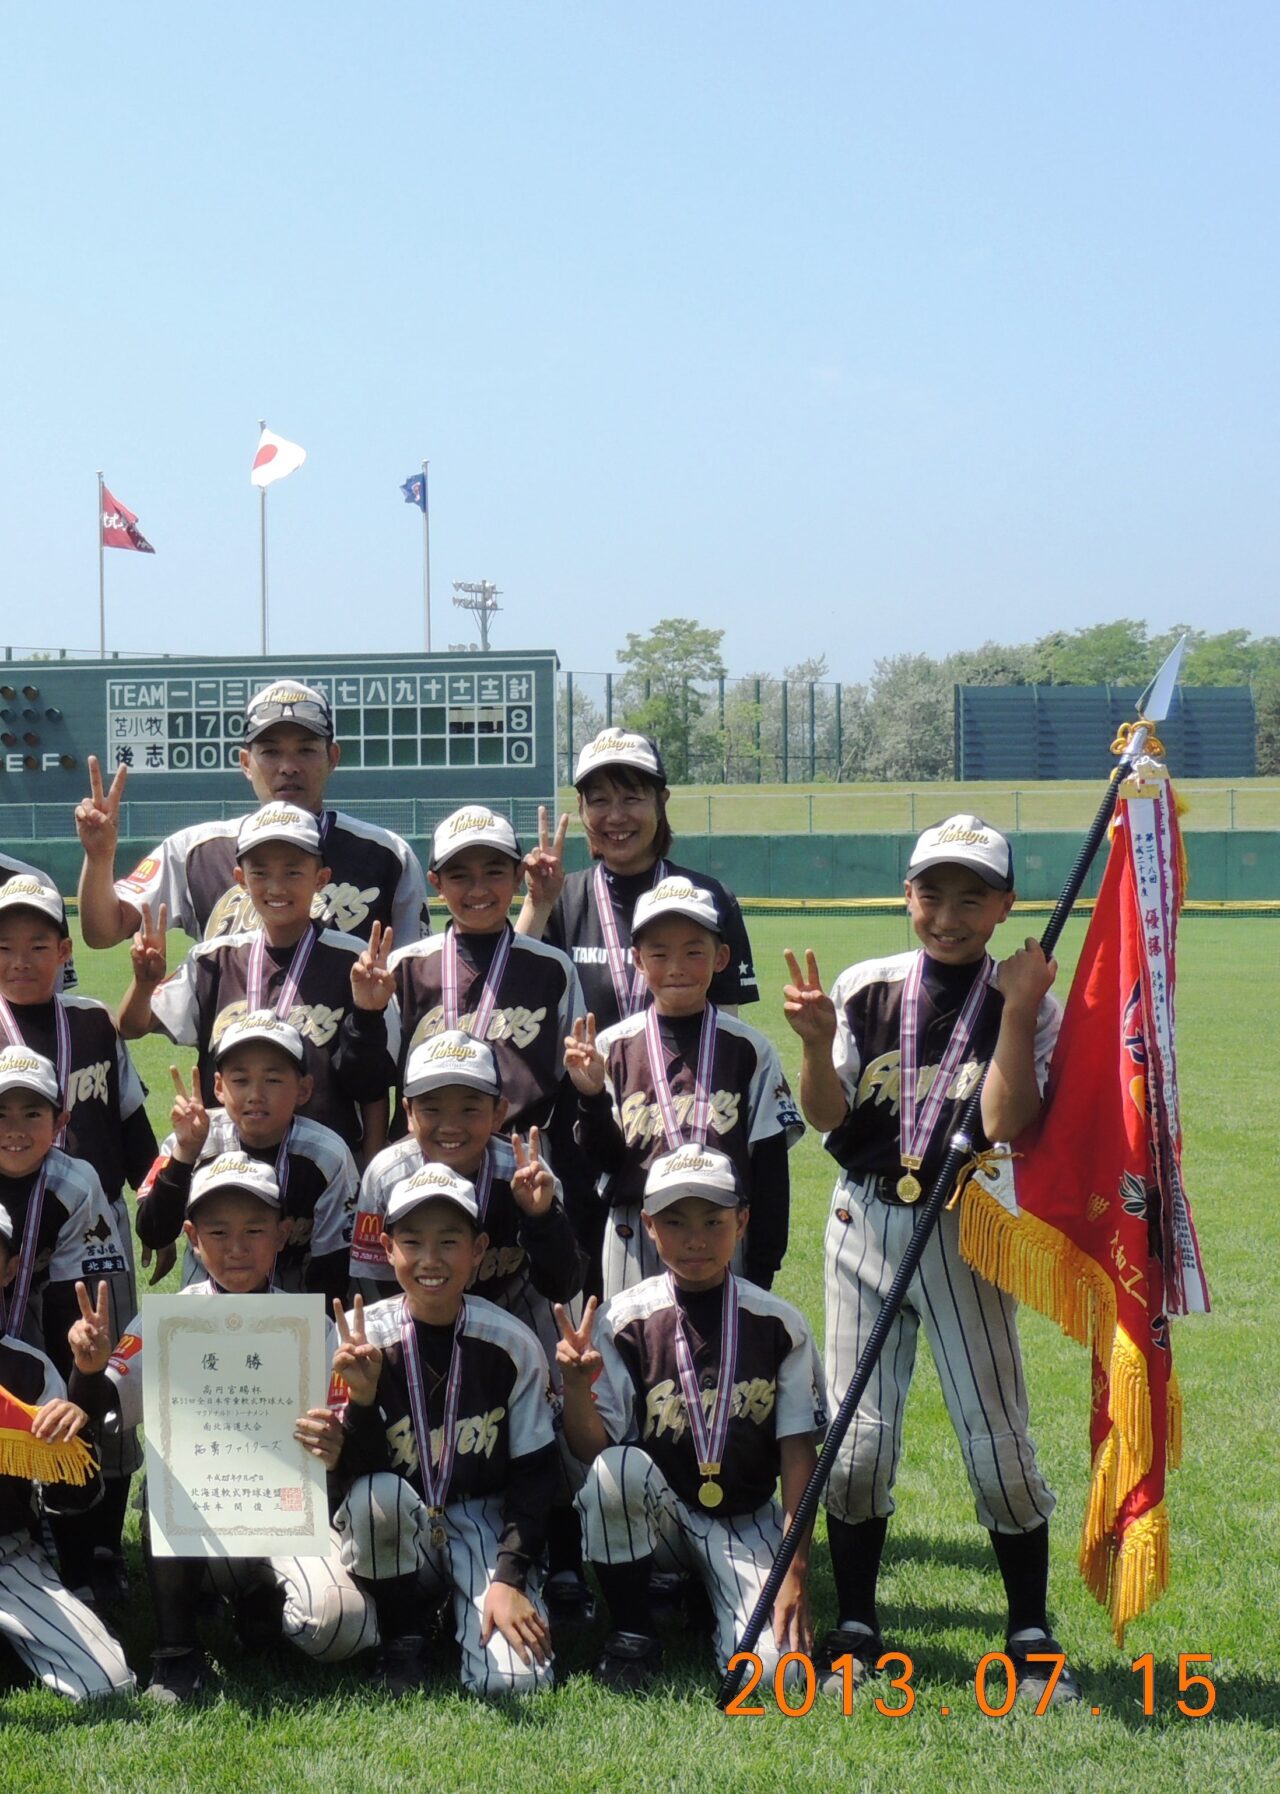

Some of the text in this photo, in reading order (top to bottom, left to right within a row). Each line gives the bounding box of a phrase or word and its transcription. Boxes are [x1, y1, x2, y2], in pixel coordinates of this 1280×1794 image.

[111, 684, 164, 706] TEAM
[198, 683, 217, 705] 二
[226, 683, 244, 705] 三
[338, 681, 358, 702] 七
[370, 681, 386, 701] 八
[396, 680, 414, 702] 九
[424, 679, 442, 701] 十
[509, 677, 529, 699] 計
[115, 716, 164, 737] 苫小牧
[175, 716, 184, 737] 1
[200, 715, 217, 737] 7
[510, 709, 528, 731] 8
[6, 753, 60, 772] E F
[115, 744, 164, 768] 後志
[172, 746, 189, 768] 0
[200, 746, 217, 767] 0
[511, 740, 528, 763] 0
[201, 1351, 264, 1371] 優勝
